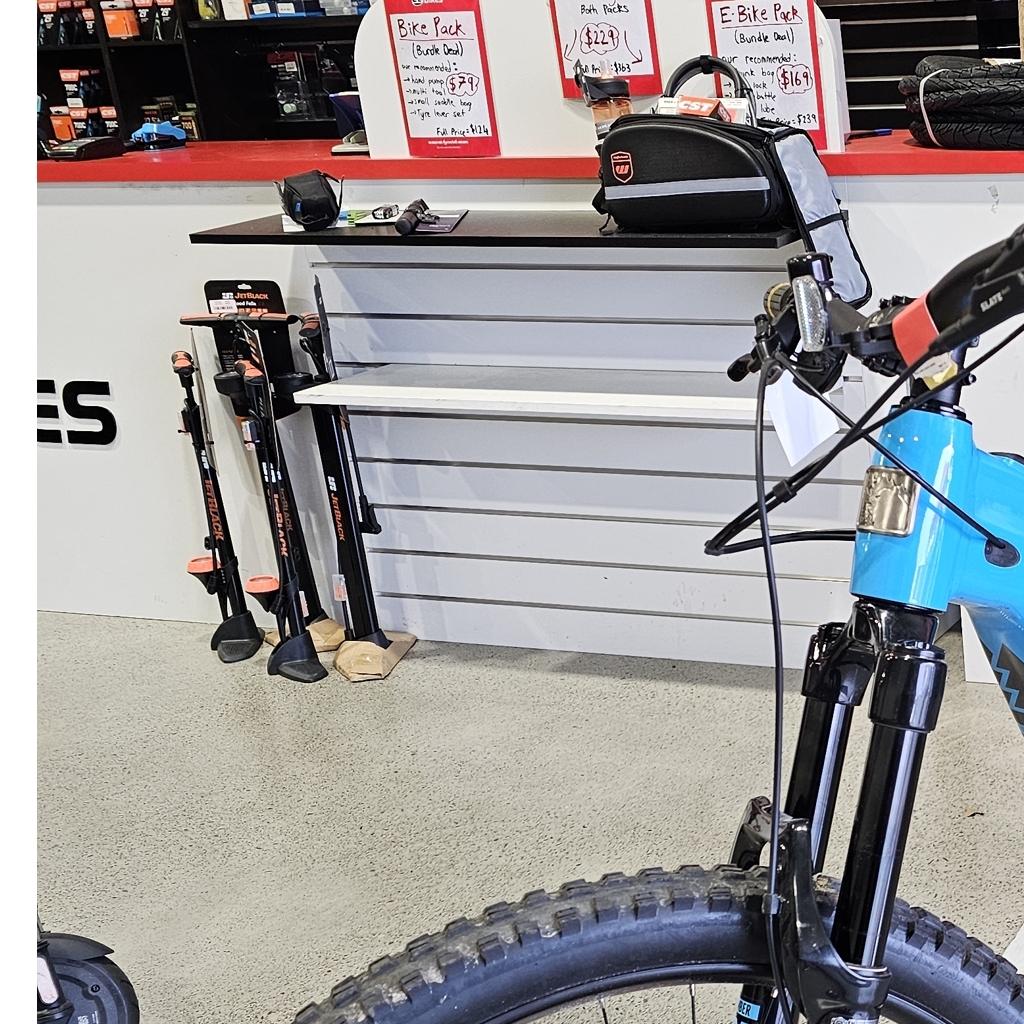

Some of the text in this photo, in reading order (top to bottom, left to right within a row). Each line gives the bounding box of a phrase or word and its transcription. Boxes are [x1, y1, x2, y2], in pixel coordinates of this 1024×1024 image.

[580, 4, 630, 15] Both Packs
[773, 3, 803, 22] Pack
[397, 16, 466, 38] Bike Pack
[584, 26, 616, 49] $229
[449, 75, 474, 92] $79
[781, 68, 810, 90] $169
[680, 101, 715, 112] CST
